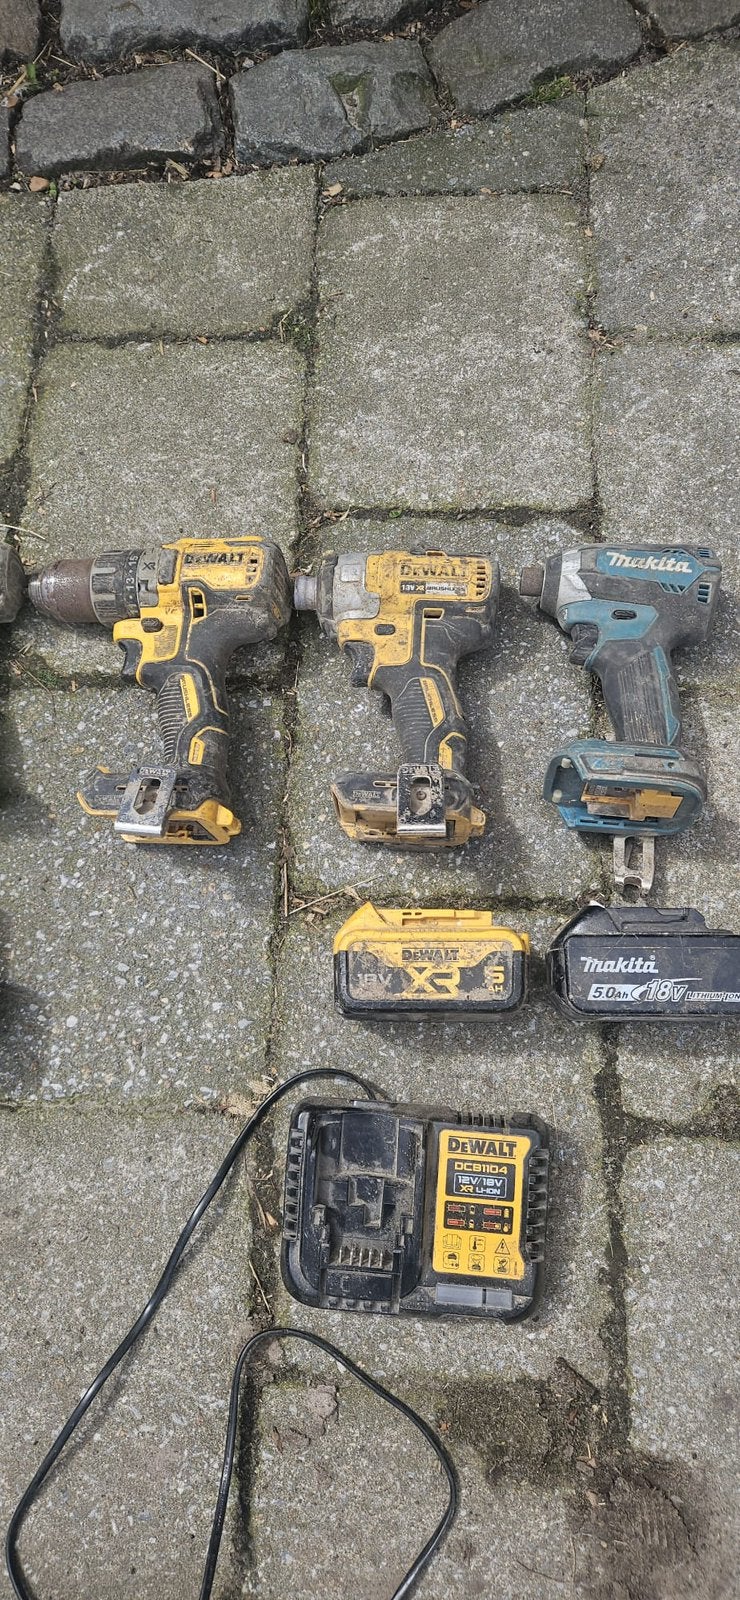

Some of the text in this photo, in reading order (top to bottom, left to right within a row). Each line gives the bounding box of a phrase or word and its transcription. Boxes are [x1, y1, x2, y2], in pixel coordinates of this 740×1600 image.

[606, 552, 692, 573] Makita
[126, 577, 135, 591] 13
[580, 956, 658, 973] Makita
[401, 966, 460, 998] XR
[645, 979, 688, 1002] 18V
[454, 1161, 508, 1175] DCB1104
[460, 1184, 474, 1193] XR
